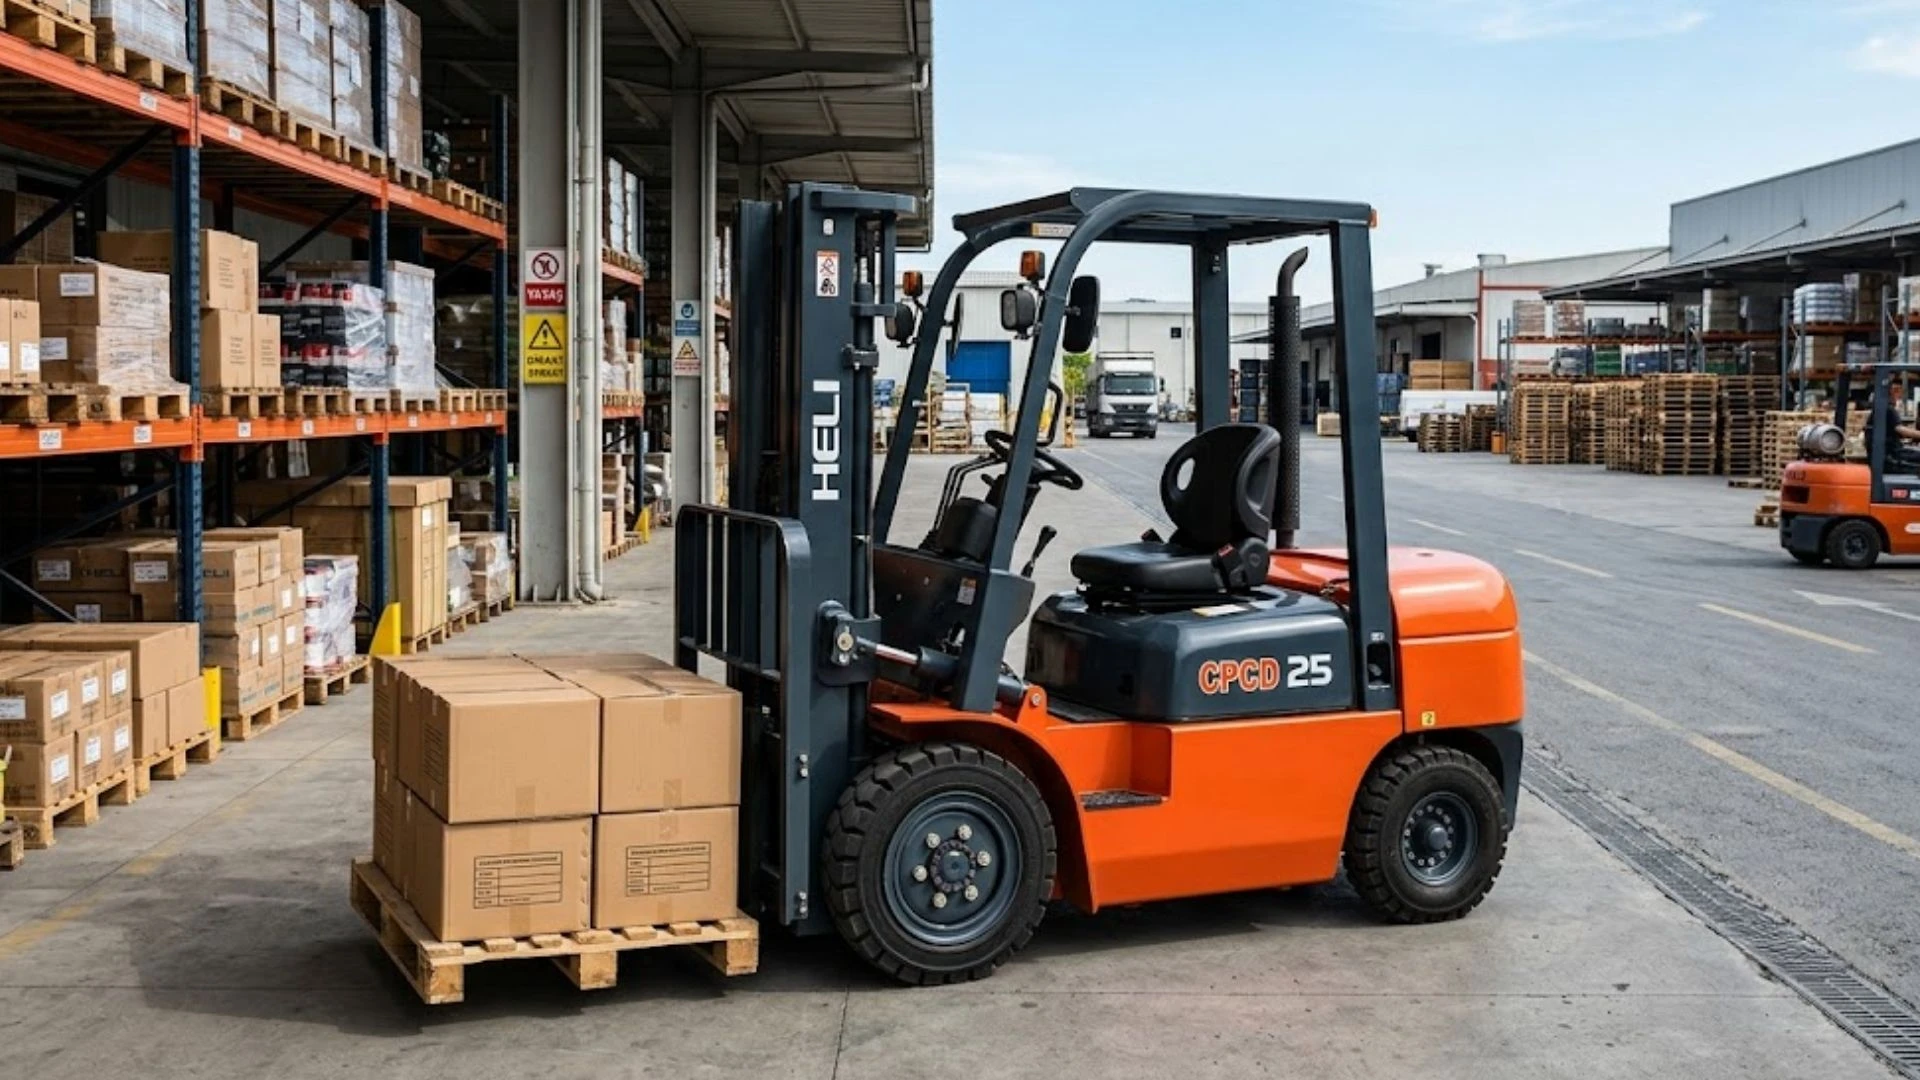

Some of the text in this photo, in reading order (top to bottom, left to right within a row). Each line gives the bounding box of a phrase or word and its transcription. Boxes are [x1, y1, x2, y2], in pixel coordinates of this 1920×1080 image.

[812, 379, 840, 501] HELI
[1199, 654, 1333, 694] CPCD 25
